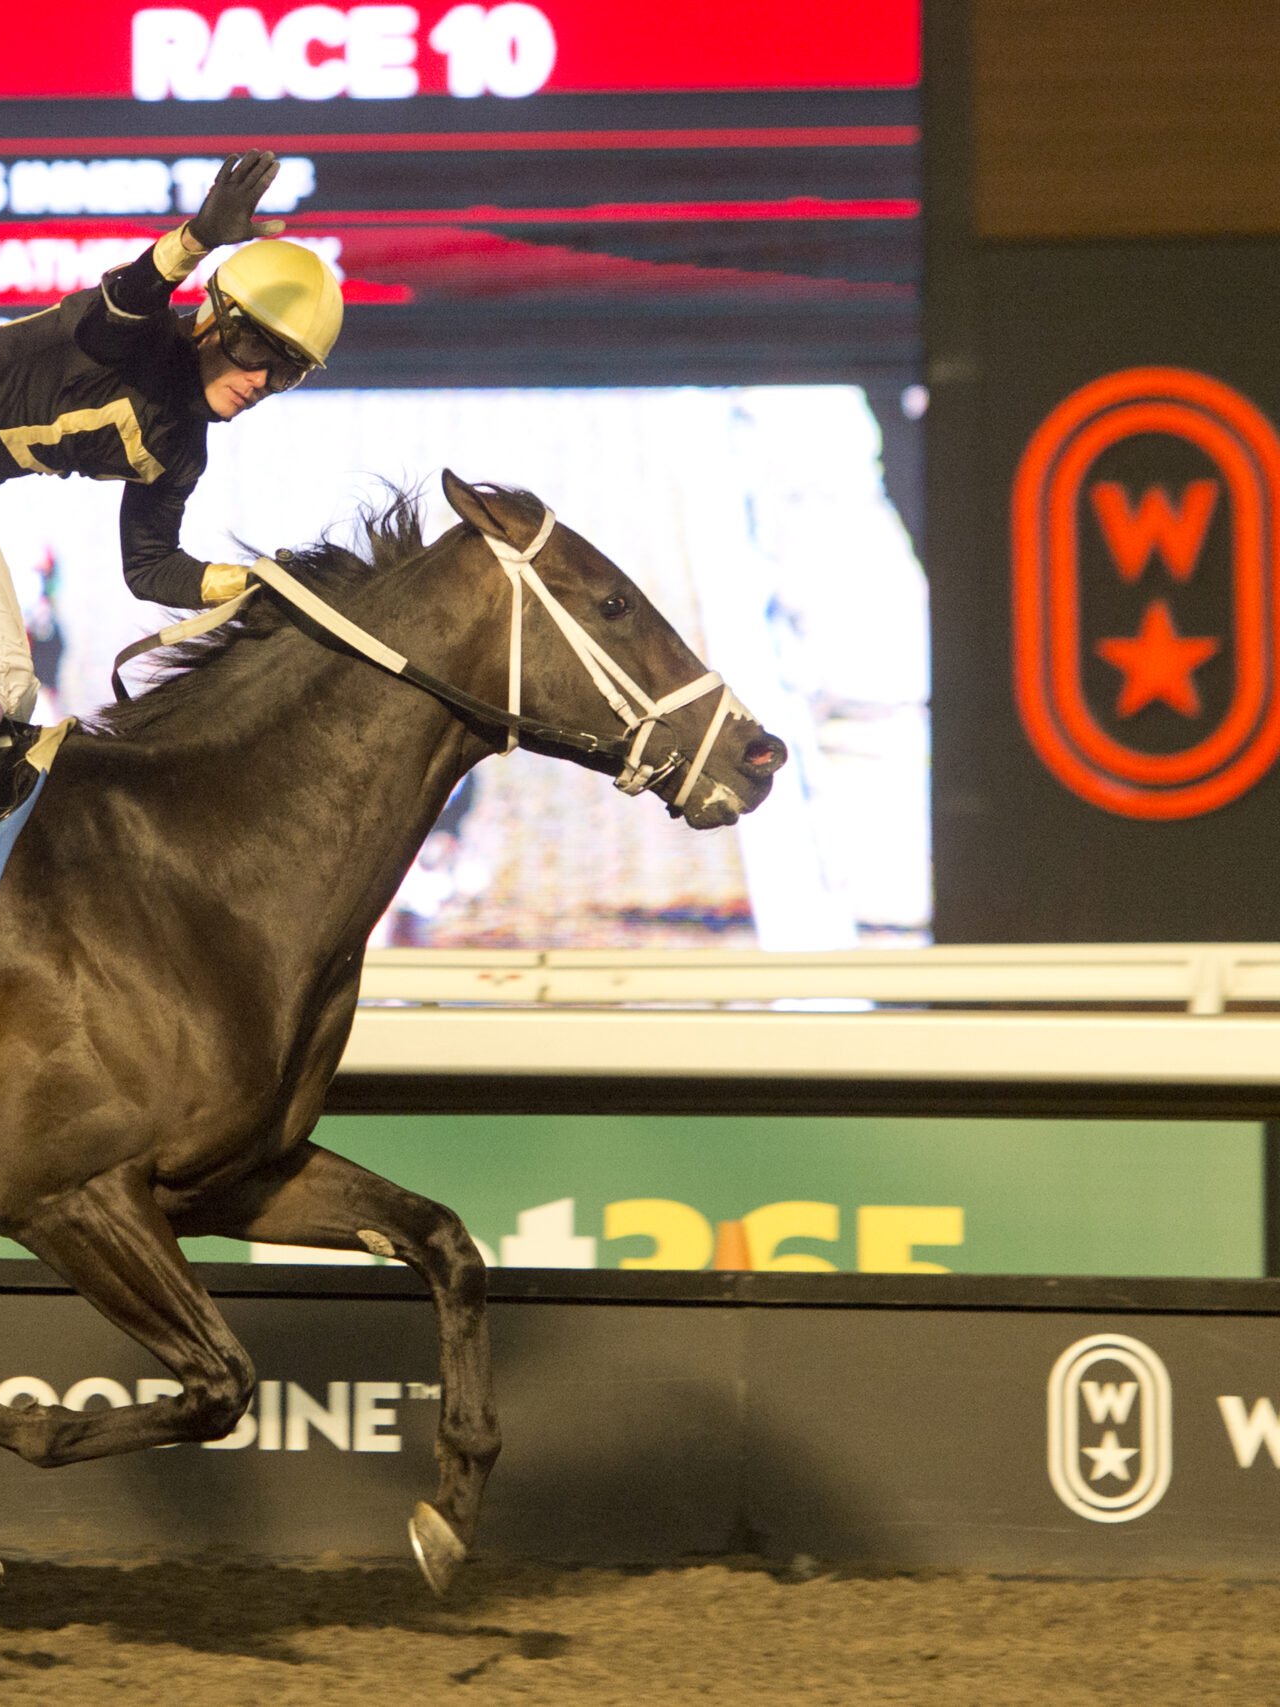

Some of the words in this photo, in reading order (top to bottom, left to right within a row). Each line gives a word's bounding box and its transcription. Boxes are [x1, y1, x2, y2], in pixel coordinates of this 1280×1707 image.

[132, 5, 420, 100] RACE
[429, 3, 557, 98] 10
[1090, 480, 1220, 583] W
[1080, 1381, 1139, 1425] W
